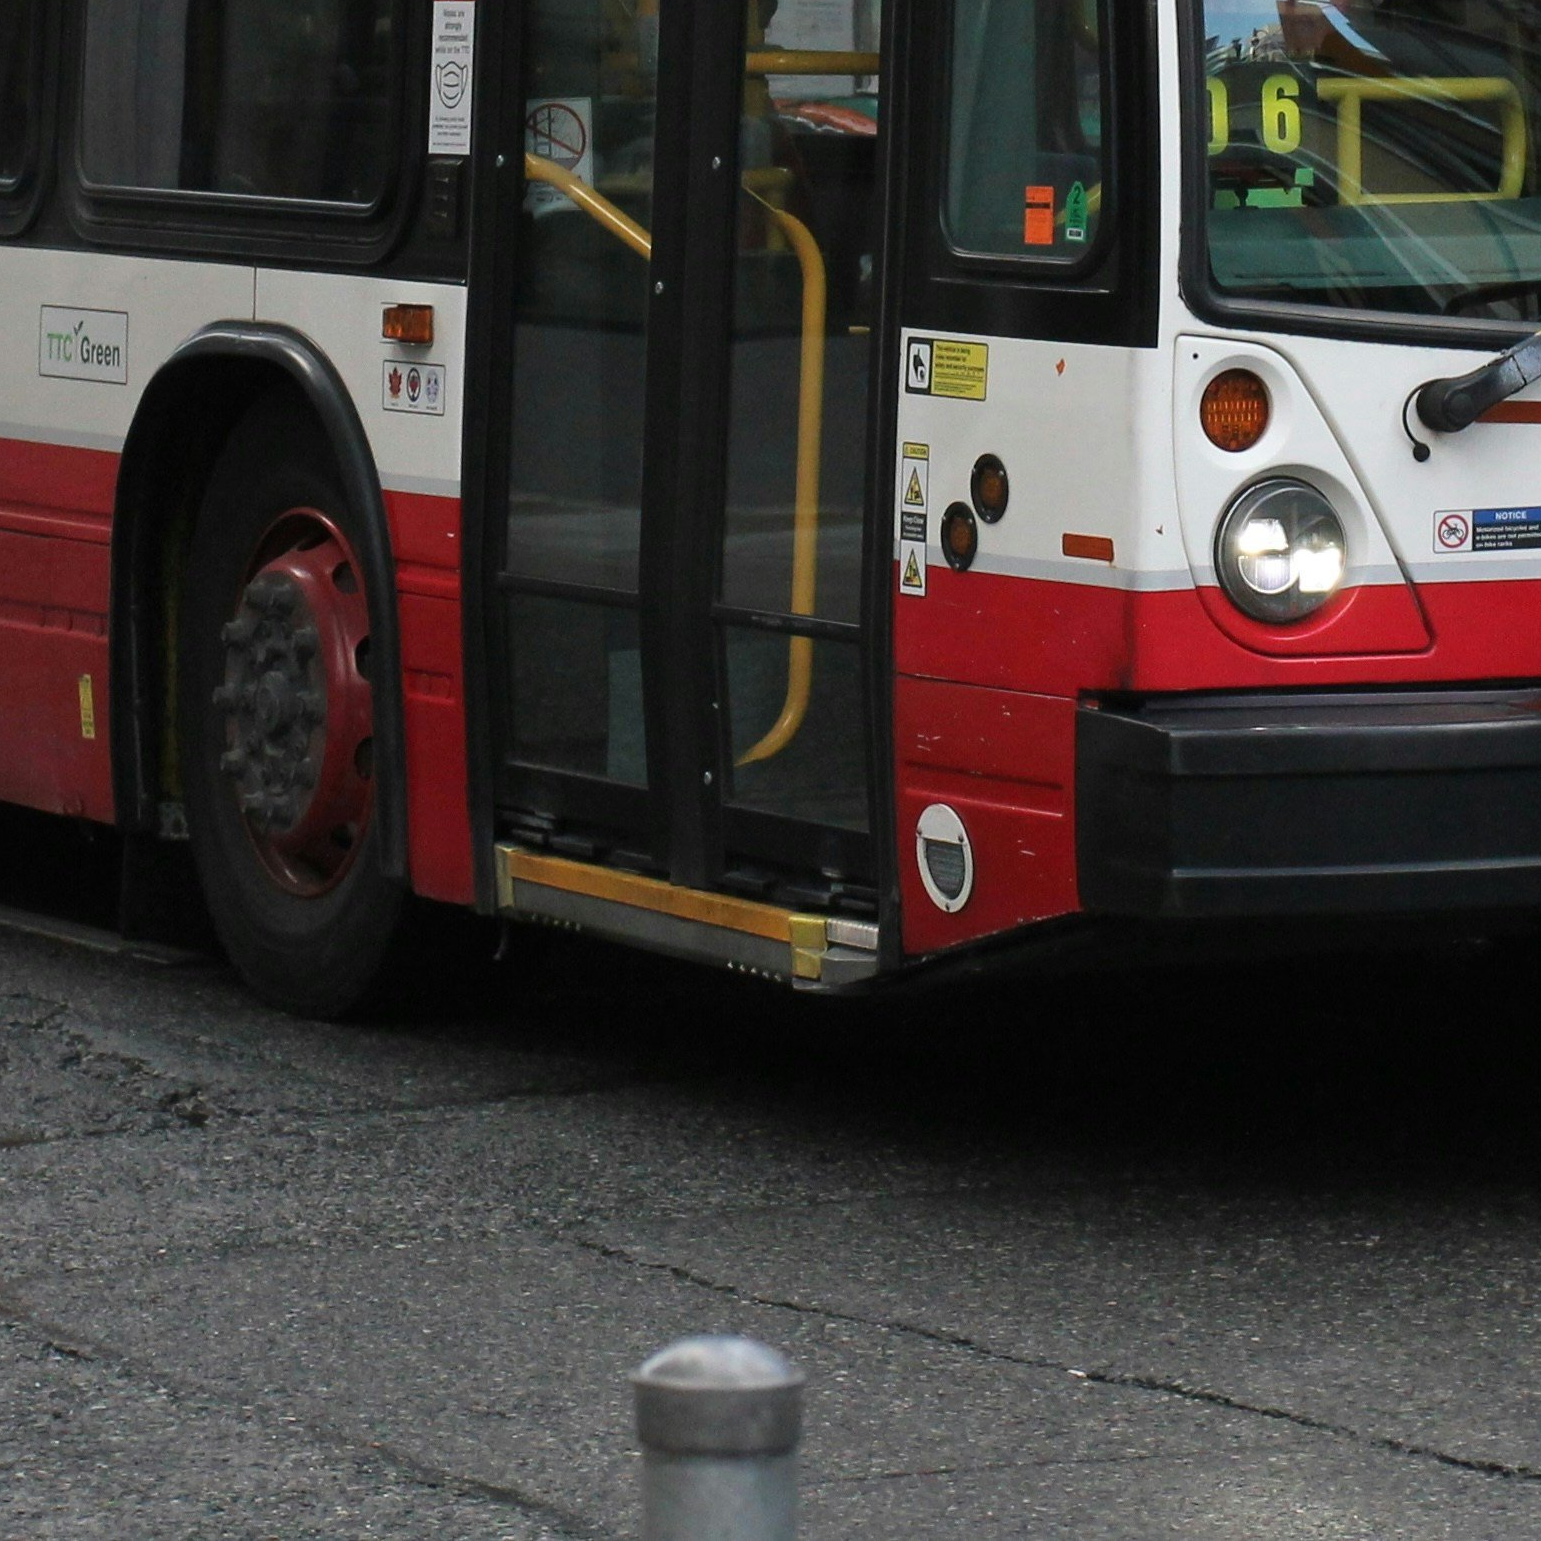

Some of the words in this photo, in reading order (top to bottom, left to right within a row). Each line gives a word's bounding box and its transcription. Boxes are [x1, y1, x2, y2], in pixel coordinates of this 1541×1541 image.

[1262, 74, 1301, 154] 6
[46, 332, 73, 363] TTC
[79, 335, 121, 368] Green
[1495, 510, 1527, 519] NOTICE
